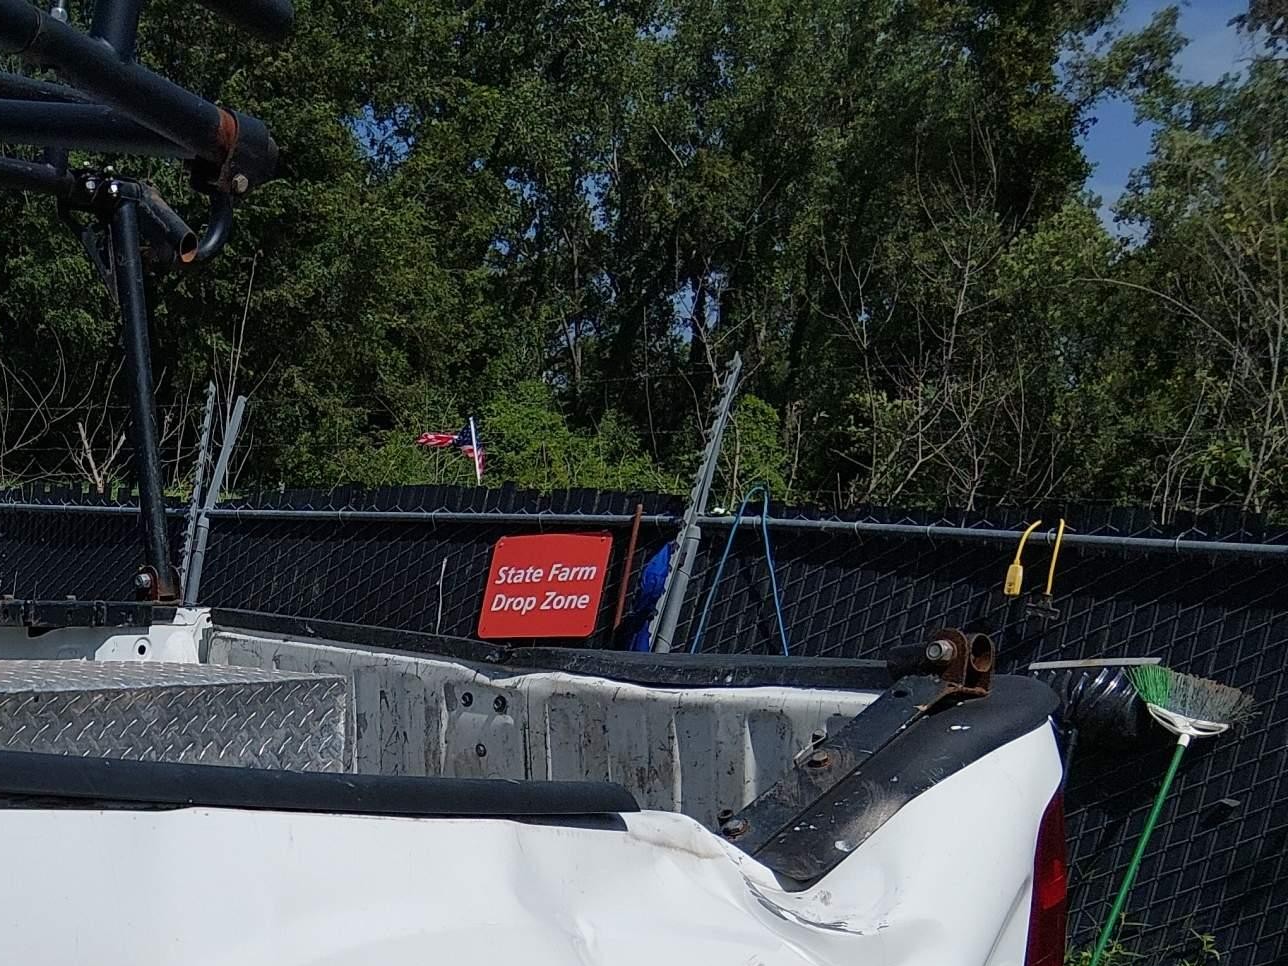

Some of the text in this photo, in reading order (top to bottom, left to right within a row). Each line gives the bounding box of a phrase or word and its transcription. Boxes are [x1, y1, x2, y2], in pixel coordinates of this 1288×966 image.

[495, 563, 597, 585] State Farm
[491, 591, 590, 615] Drop Zone
